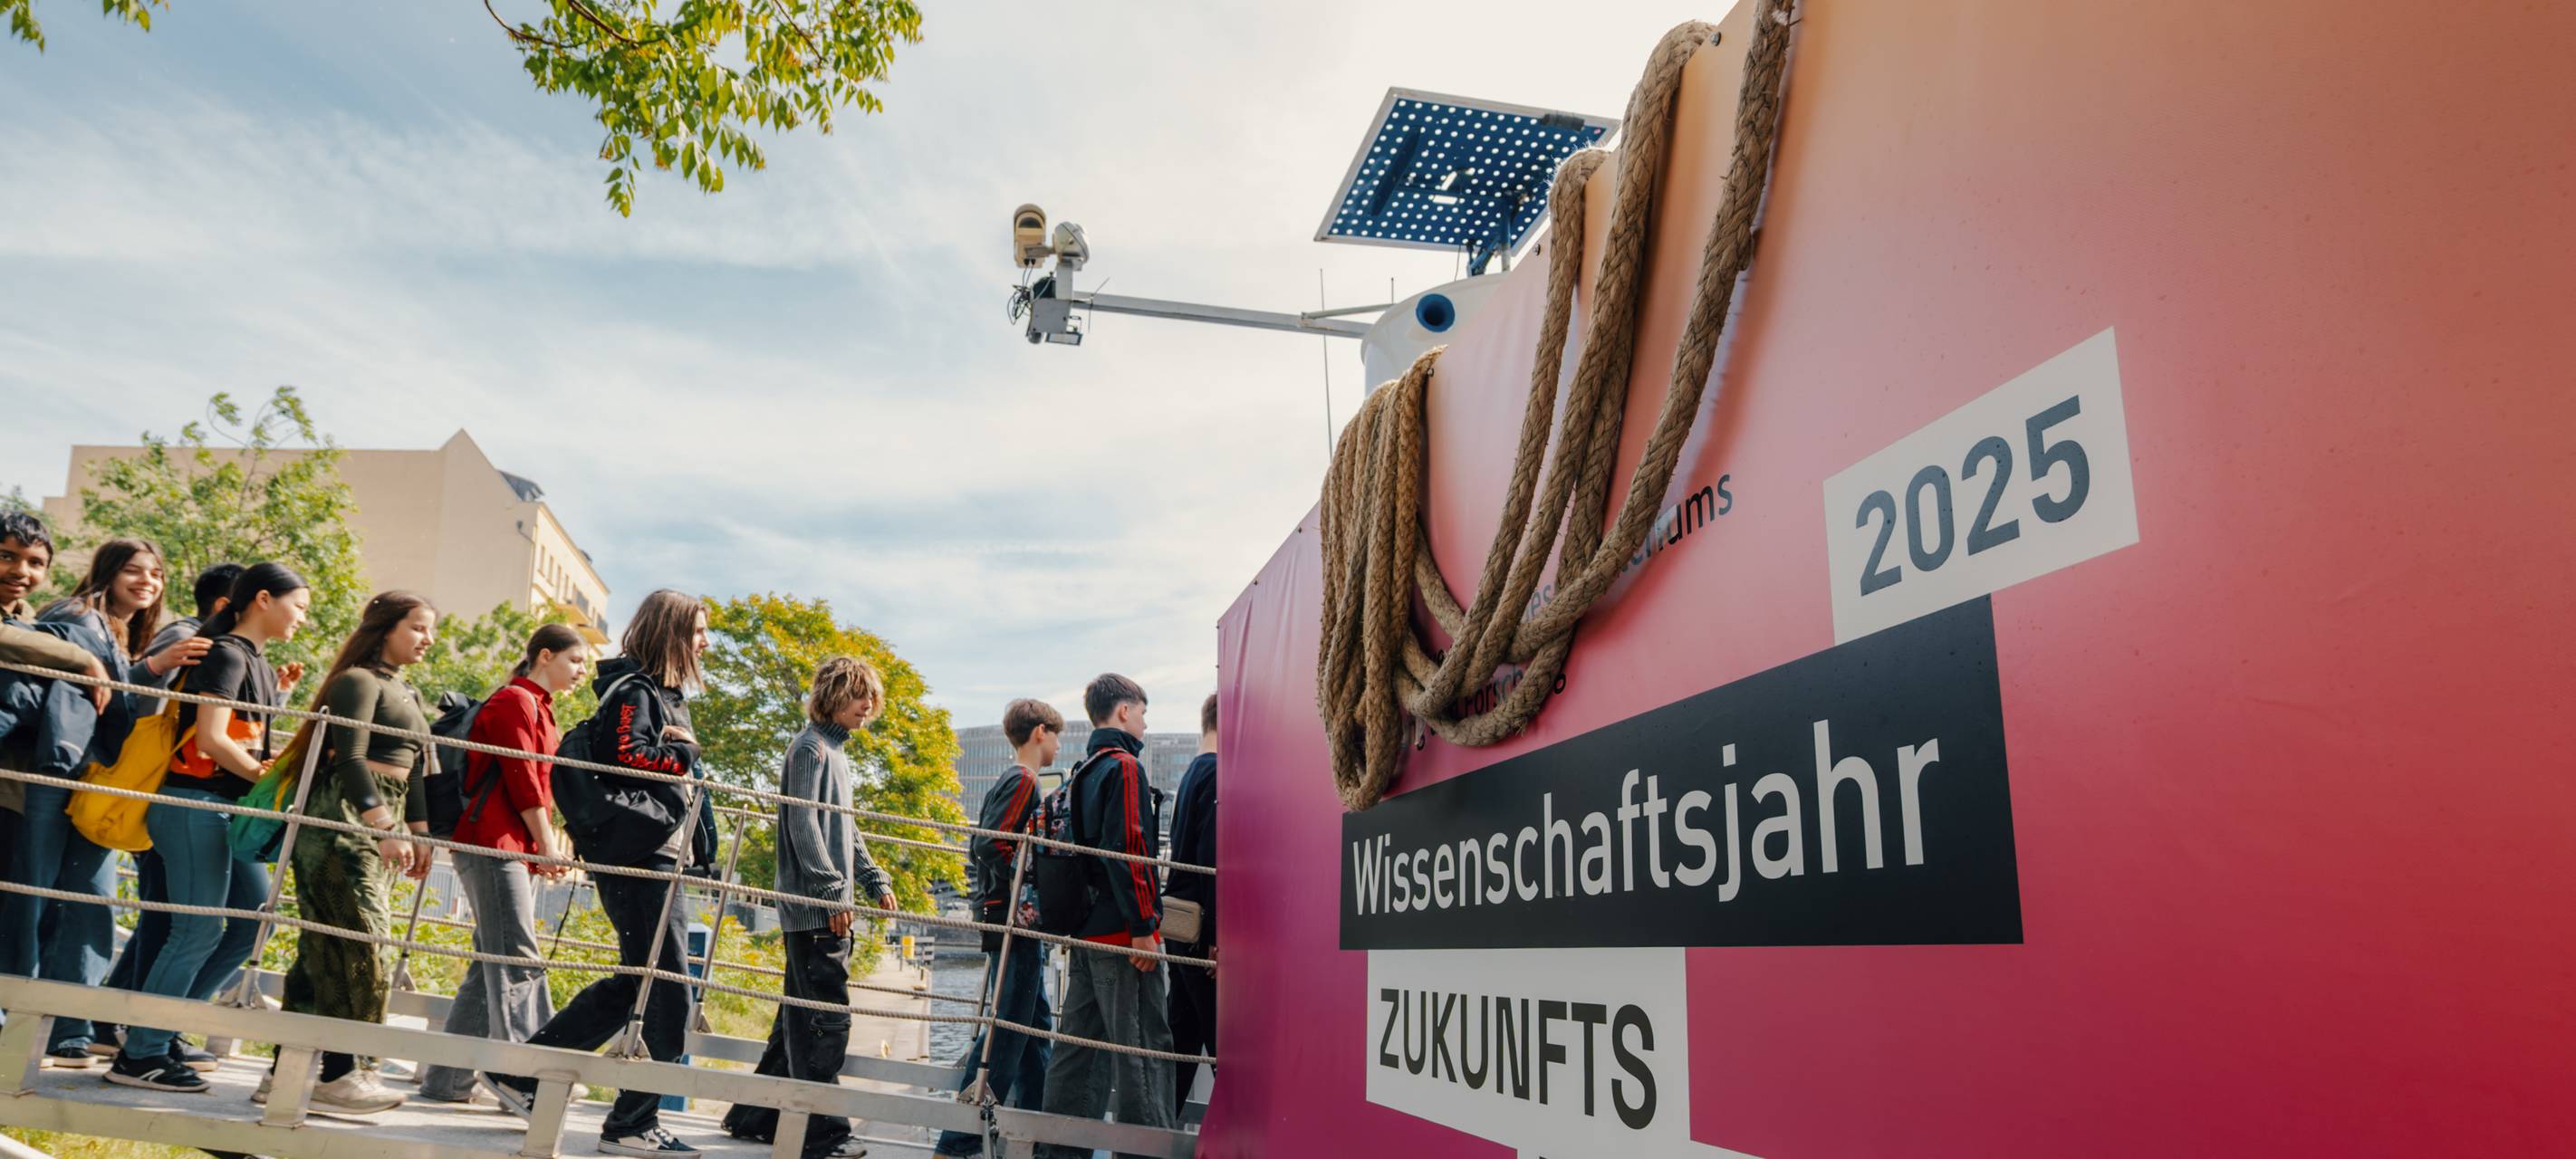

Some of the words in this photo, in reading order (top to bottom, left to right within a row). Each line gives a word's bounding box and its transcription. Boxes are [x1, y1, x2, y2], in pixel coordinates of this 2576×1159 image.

[1854, 394, 2091, 597] 2025
[1352, 719, 1940, 915] Wissenschaftsjahr
[1379, 988, 1658, 1130] ZUKUNFTS
